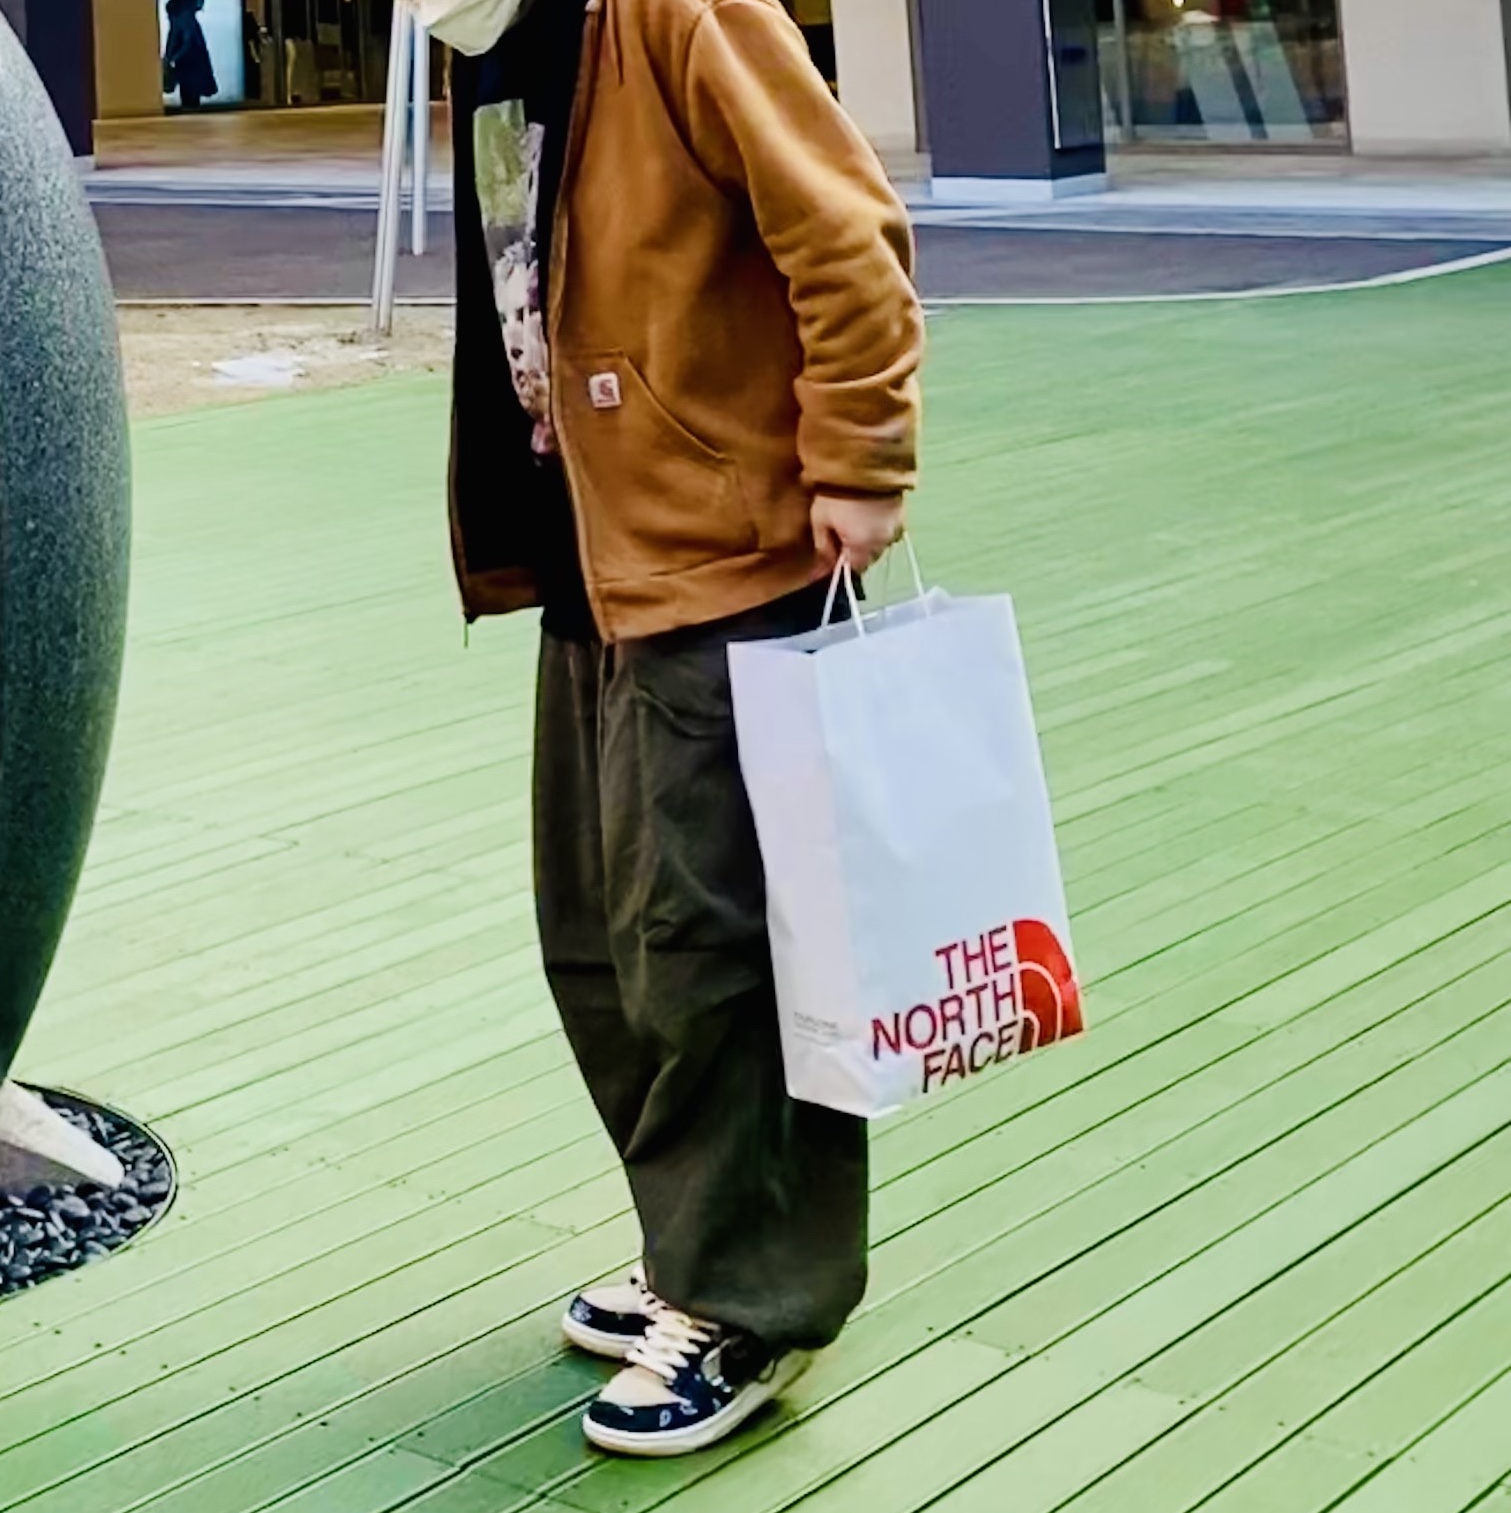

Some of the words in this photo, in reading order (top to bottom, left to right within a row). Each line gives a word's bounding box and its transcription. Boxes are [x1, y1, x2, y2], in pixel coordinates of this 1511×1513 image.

[934, 924, 1013, 990] THE
[870, 972, 1018, 1062] NORTH
[921, 1018, 1019, 1095] FACE
